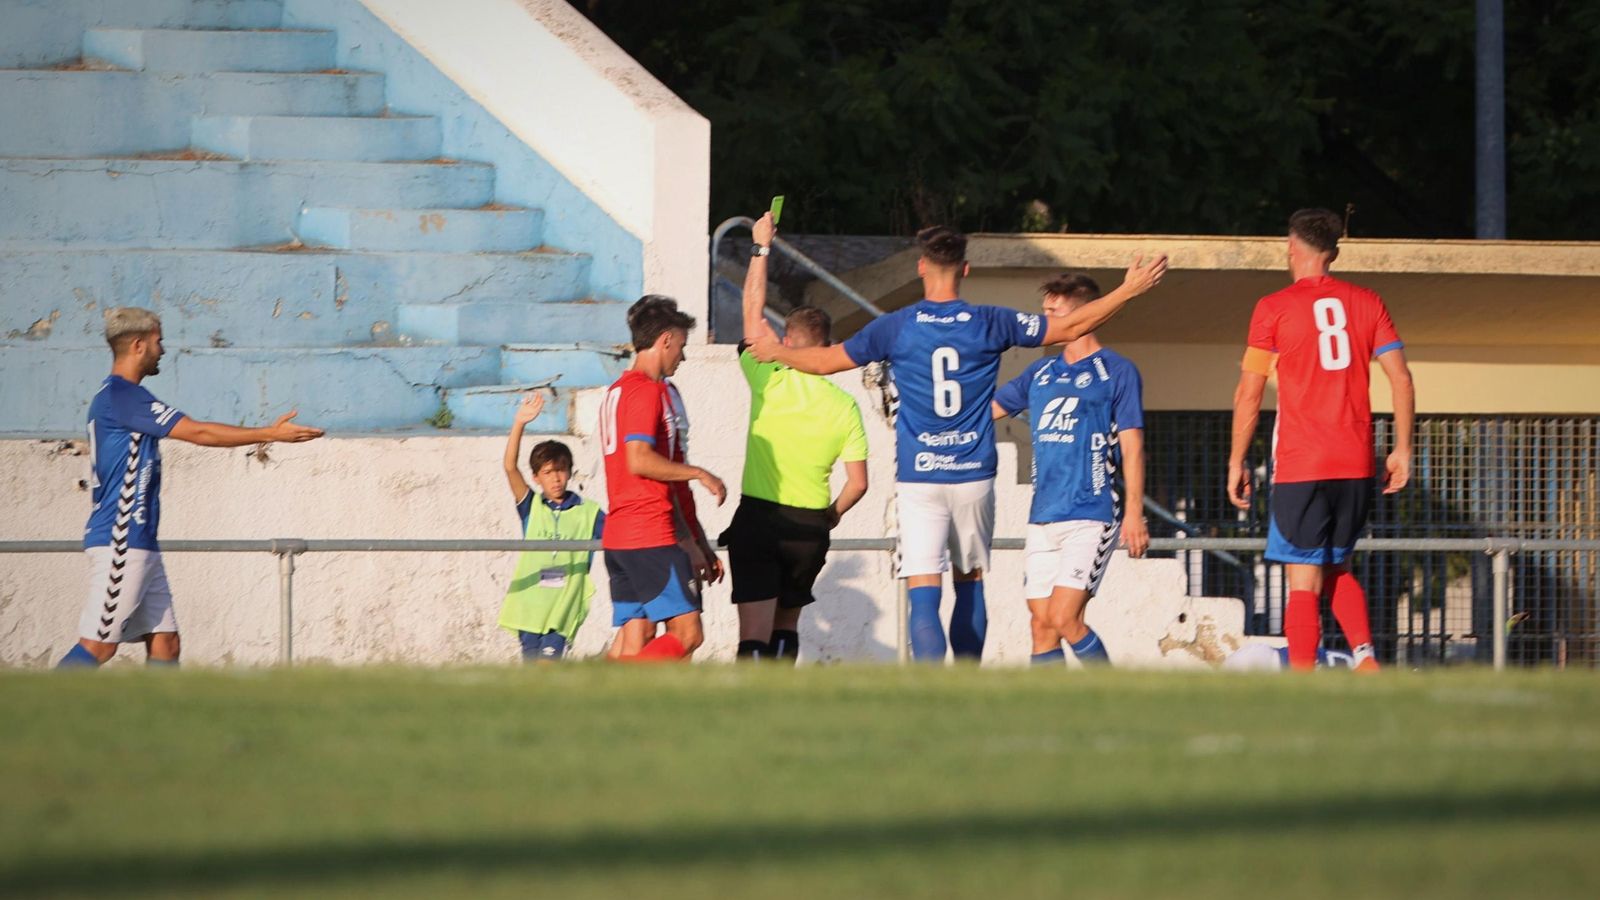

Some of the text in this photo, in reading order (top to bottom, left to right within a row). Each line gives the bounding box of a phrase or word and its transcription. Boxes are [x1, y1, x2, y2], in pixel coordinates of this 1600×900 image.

[1313, 297, 1352, 371] 8
[931, 346, 961, 417] 6
[1049, 413, 1079, 431] Air
